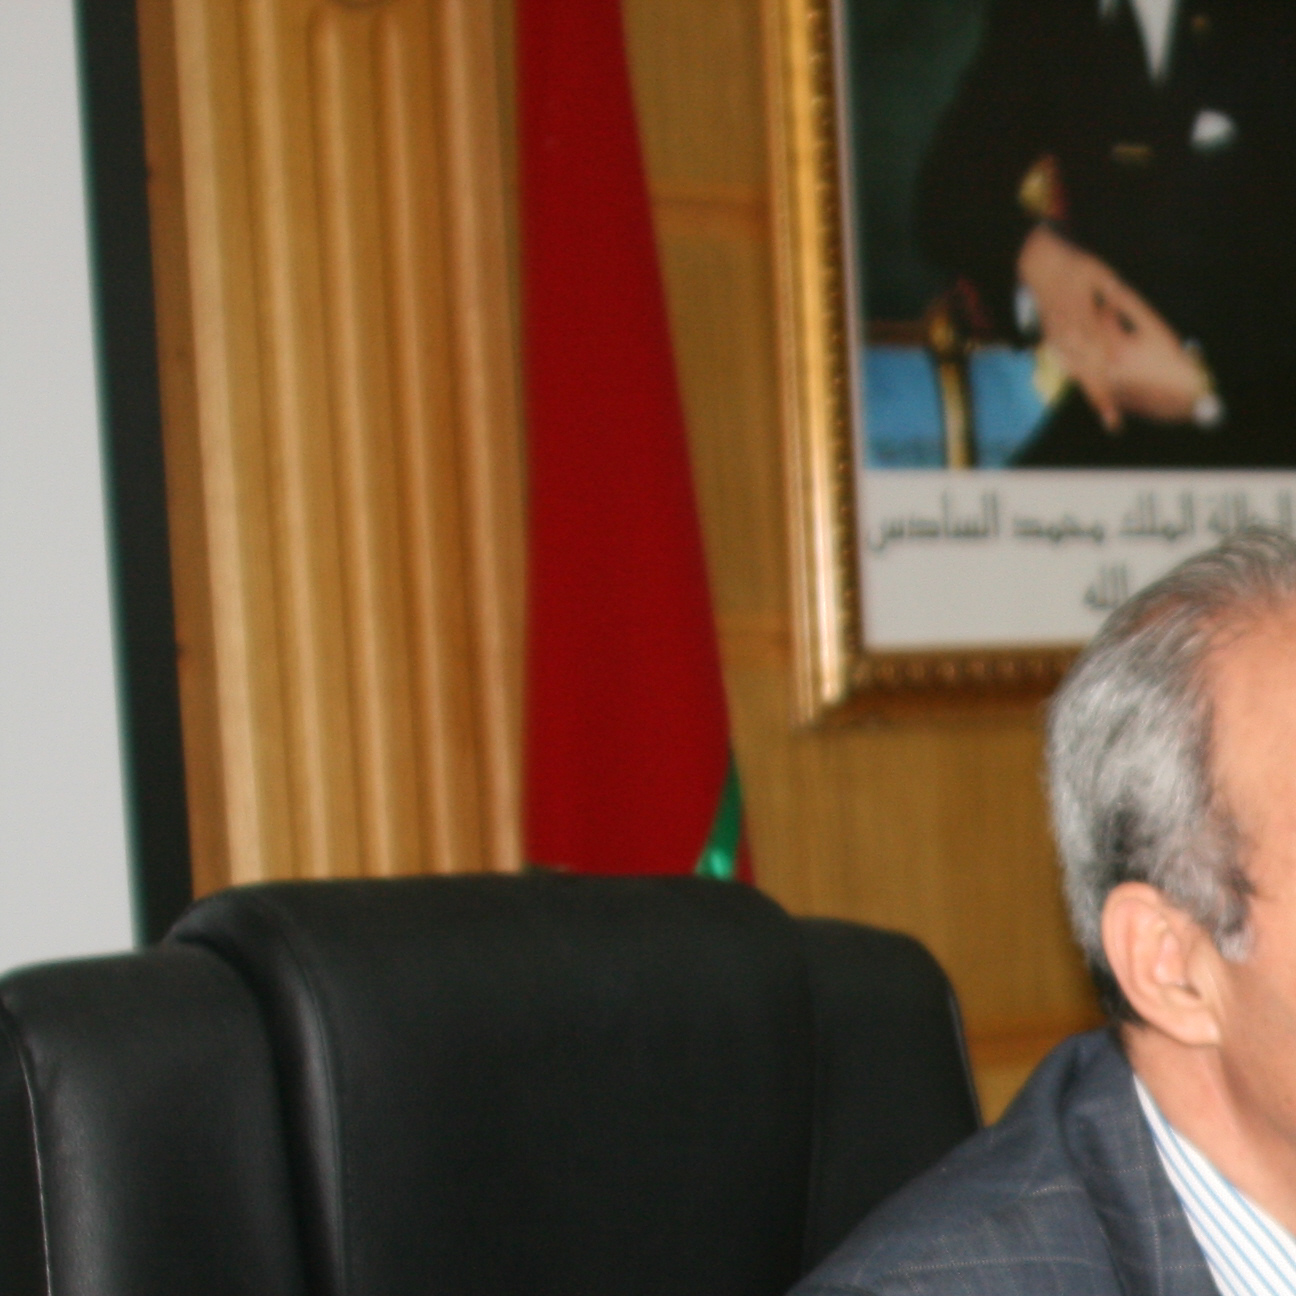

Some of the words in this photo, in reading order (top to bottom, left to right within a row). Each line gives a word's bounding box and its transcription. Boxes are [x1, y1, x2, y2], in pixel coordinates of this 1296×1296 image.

[867, 490, 998, 554] السادس
[1011, 513, 1106, 545] محمد
[1120, 490, 1195, 544] الملك
